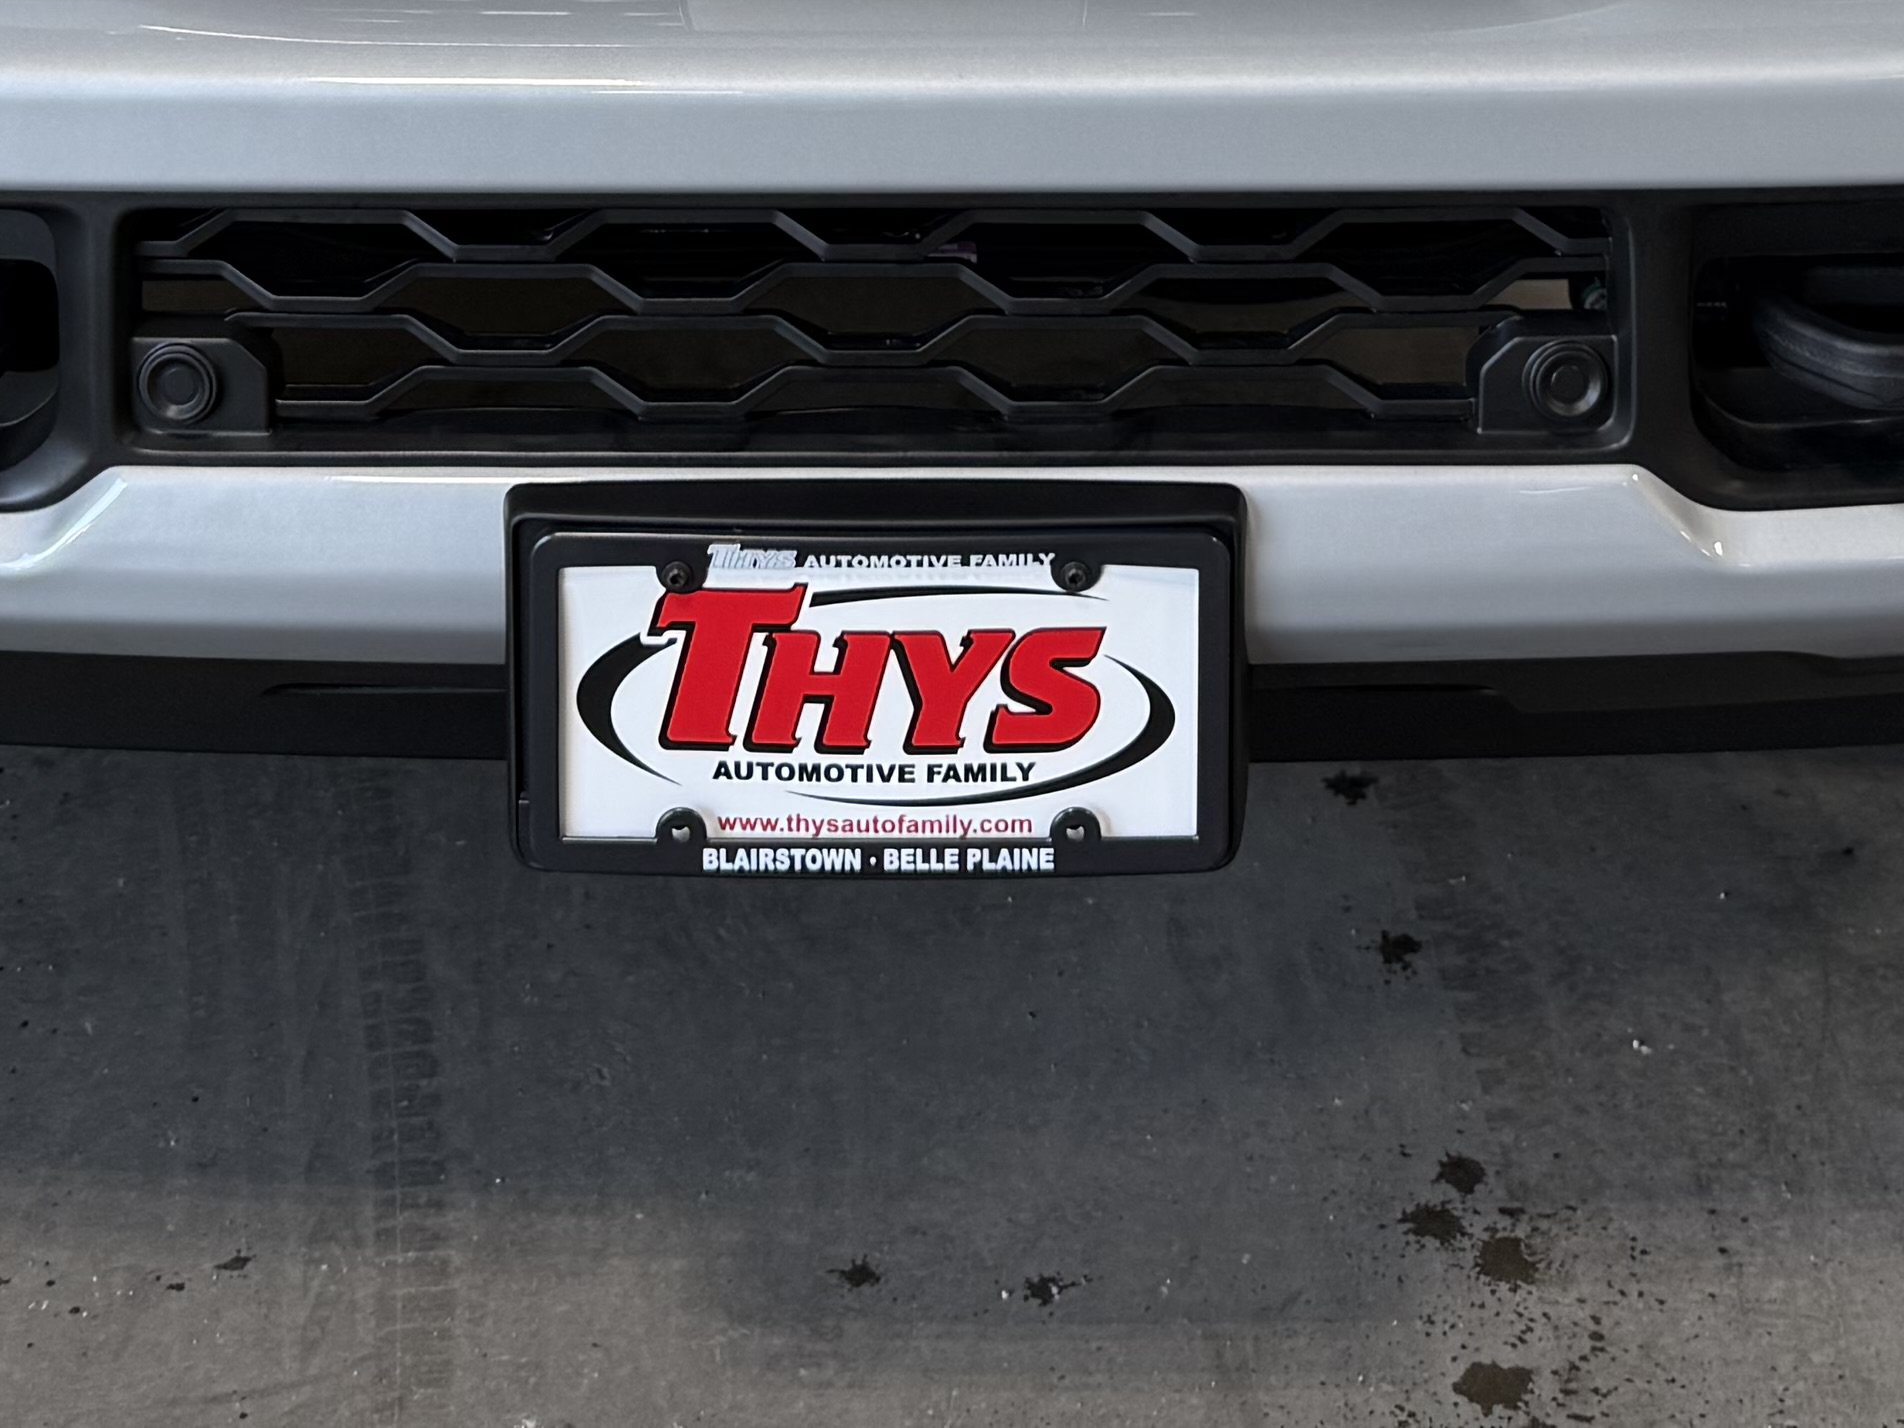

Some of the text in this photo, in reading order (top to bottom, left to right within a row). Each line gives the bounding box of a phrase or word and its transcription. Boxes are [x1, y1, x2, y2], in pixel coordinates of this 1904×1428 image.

[803, 553, 962, 569] AUTOMOTIVE
[968, 552, 1056, 568] FAMILY
[648, 583, 1107, 755] THYS
[712, 761, 1037, 785] AUTOMOTIVE FAMILY
[717, 812, 1034, 838] www.thysautofamily.com
[701, 846, 1056, 874] BLAIRSTOWN BELLE PLAINE
